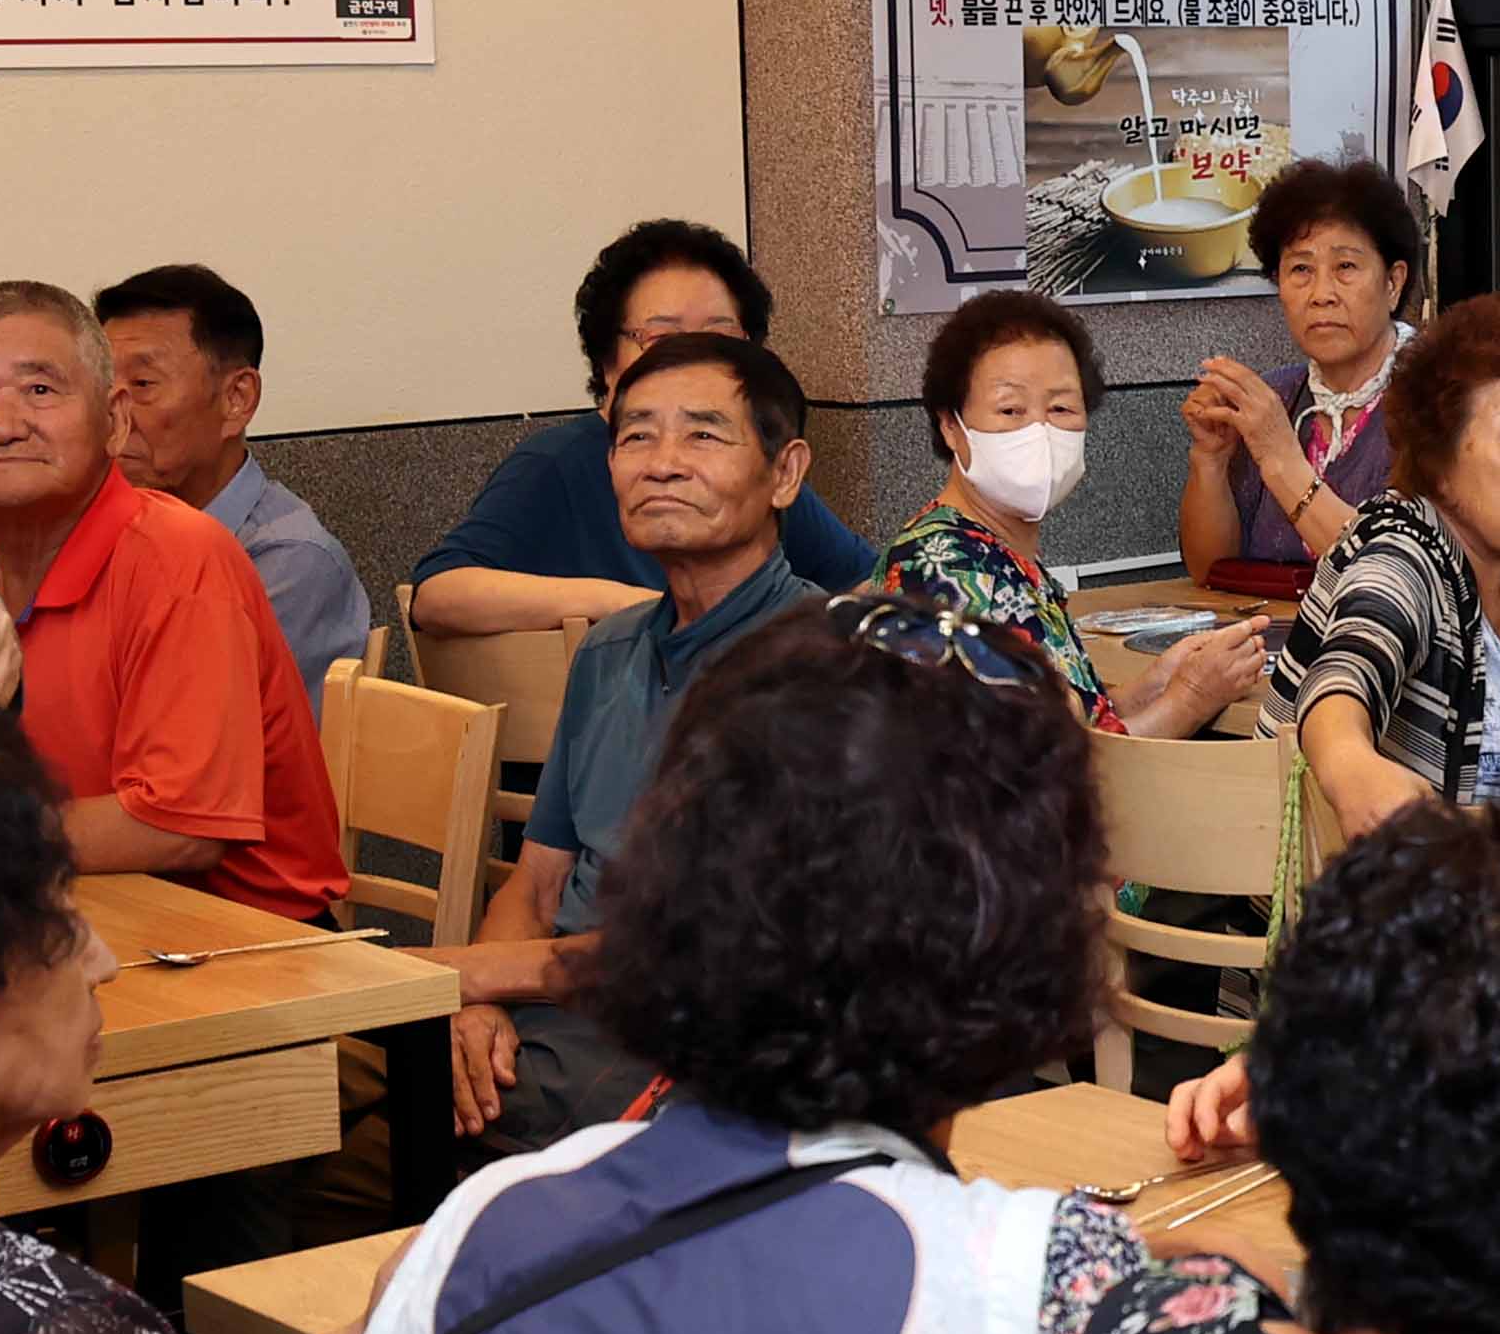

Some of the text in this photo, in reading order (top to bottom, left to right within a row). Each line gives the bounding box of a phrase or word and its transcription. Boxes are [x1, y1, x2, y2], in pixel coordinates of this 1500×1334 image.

[348, 0, 398, 15] 금연구역
[1120, 115, 1262, 144] 알고 마시면
